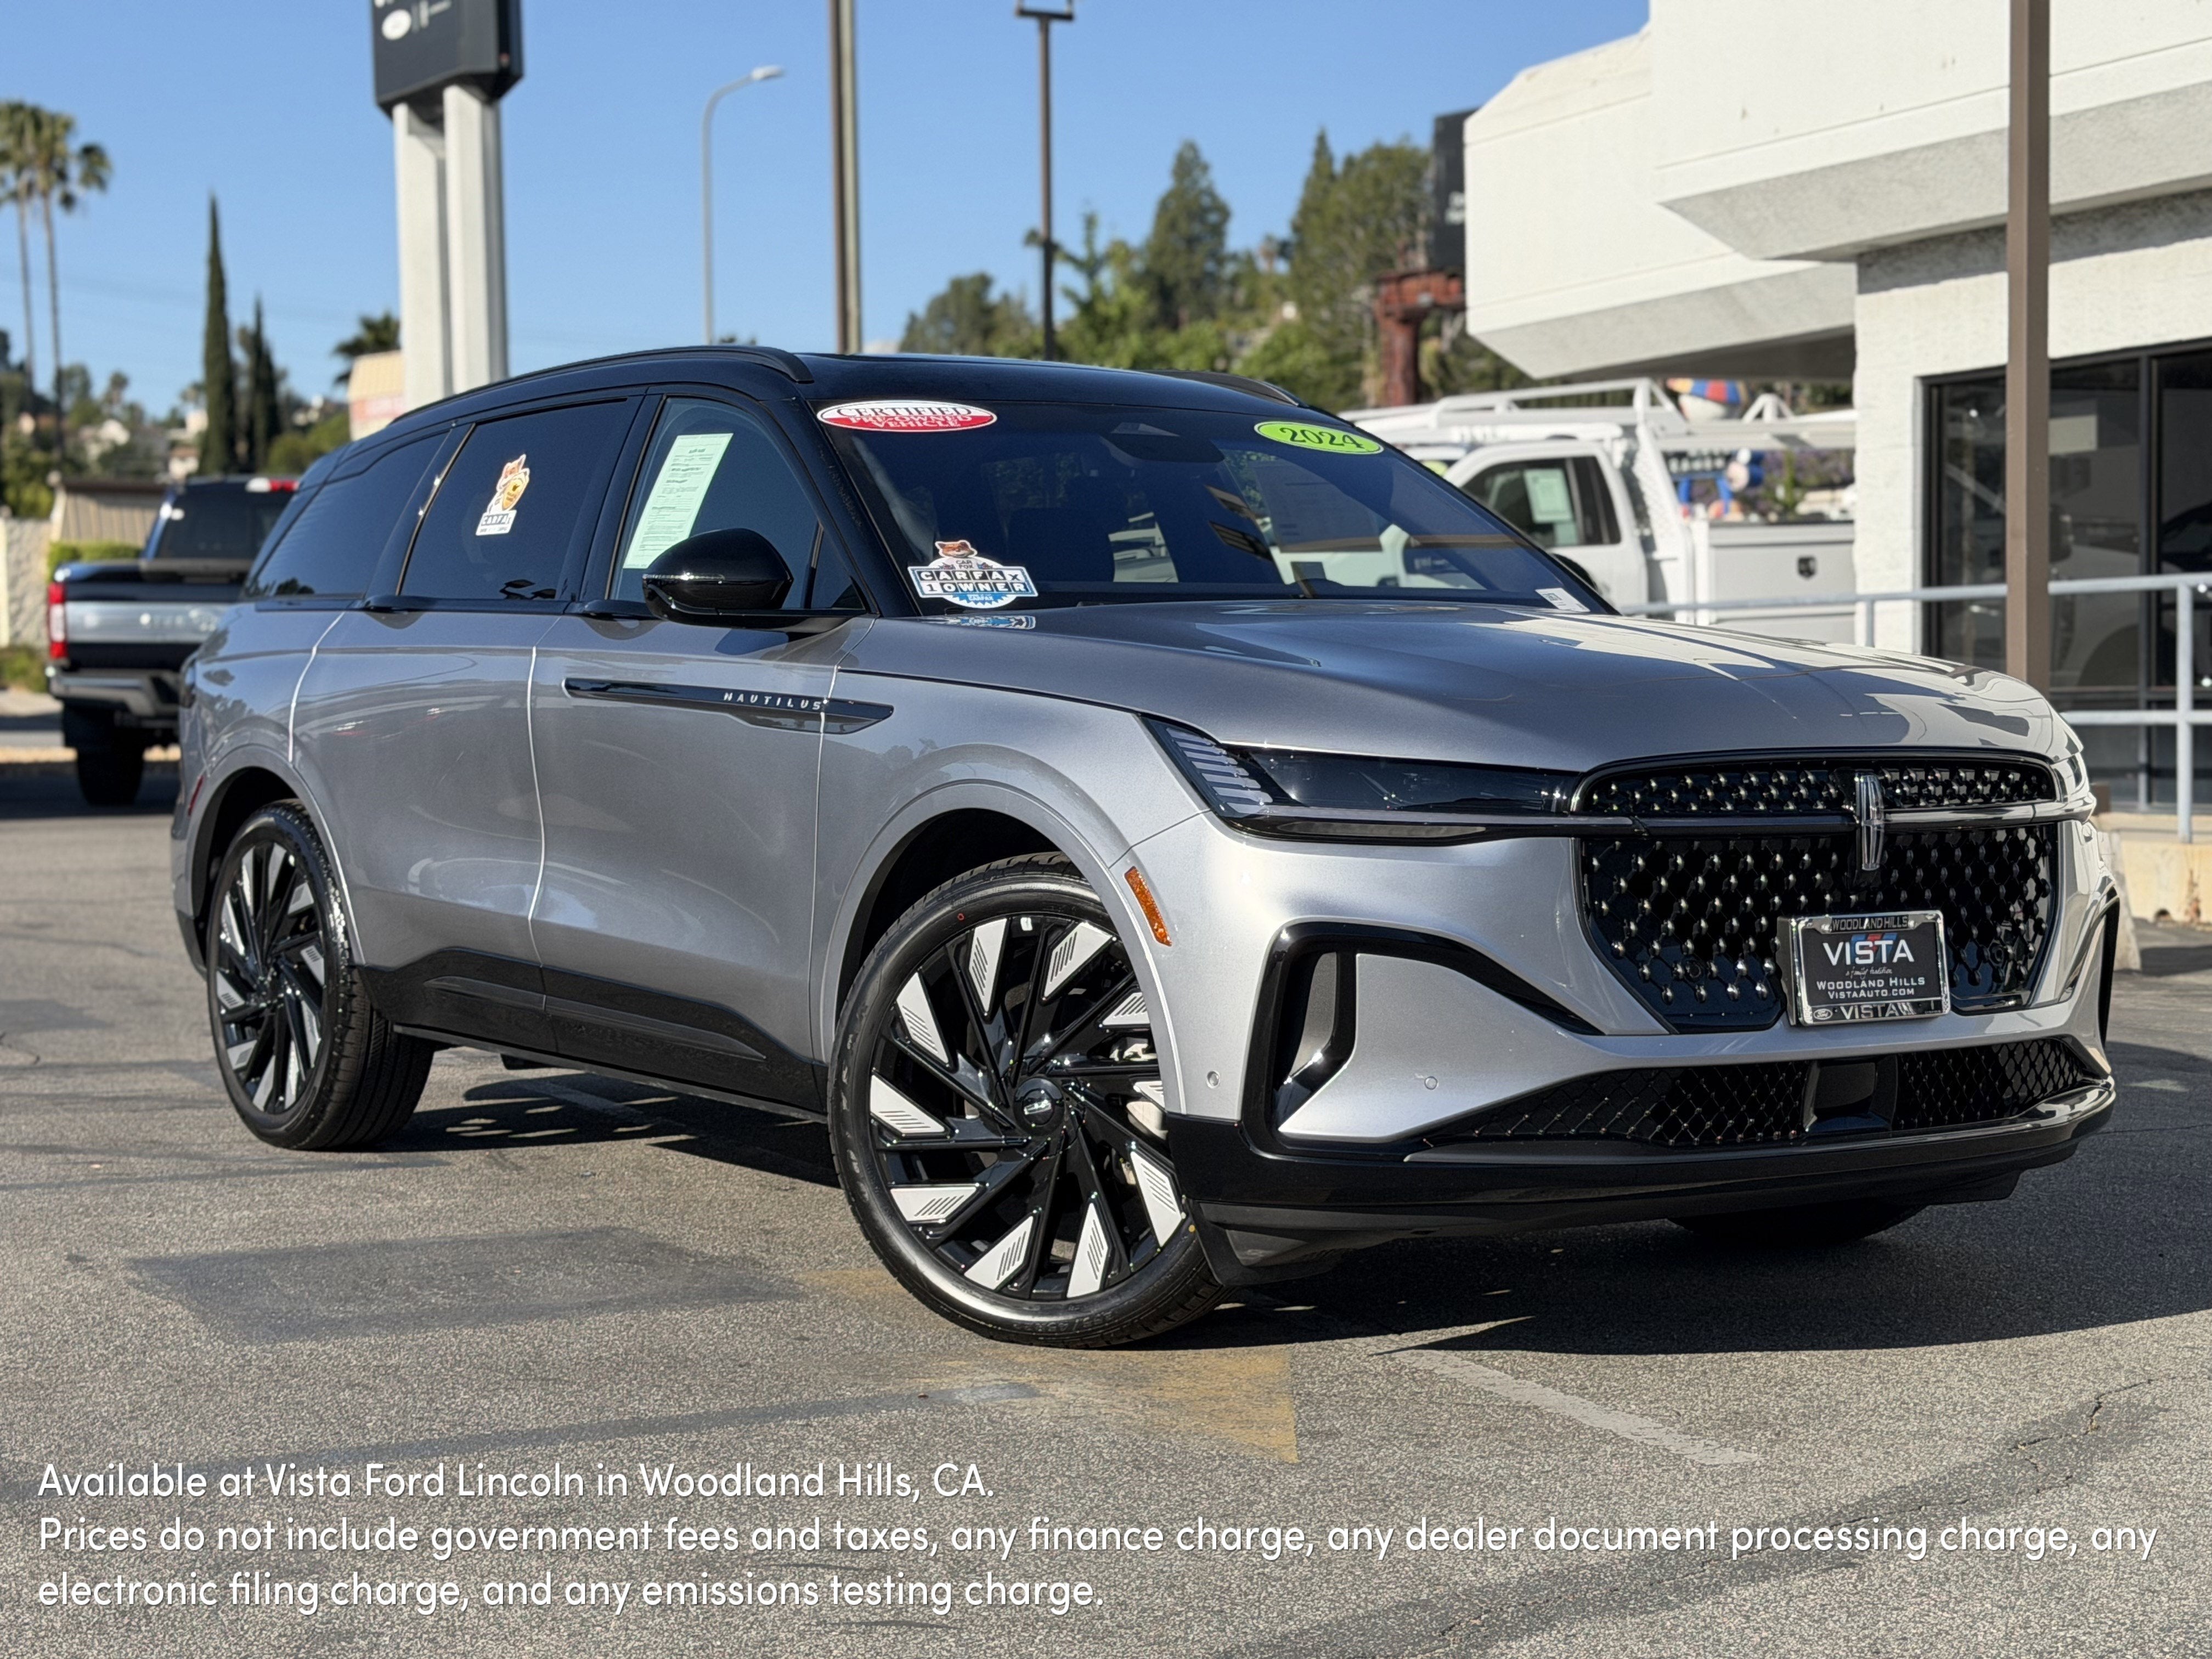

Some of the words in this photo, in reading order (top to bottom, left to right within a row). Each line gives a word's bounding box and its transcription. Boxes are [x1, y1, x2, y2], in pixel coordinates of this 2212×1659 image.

[837, 407, 972, 416] CERTIFIED
[1279, 427, 1365, 449] 2024
[919, 571, 1021, 581] CARFAX
[926, 583, 938, 592] 1
[943, 583, 1027, 592] OWNER
[723, 692, 821, 710] NAUTILUS
[1831, 917, 1883, 931] WOODLAND
[1883, 916, 1909, 928] HILLS
[1822, 939, 1915, 966] VISTA
[1816, 979, 1884, 991] WOODLAND
[1889, 977, 1926, 987] HILLS
[1839, 1003, 1900, 1020] VISTA
